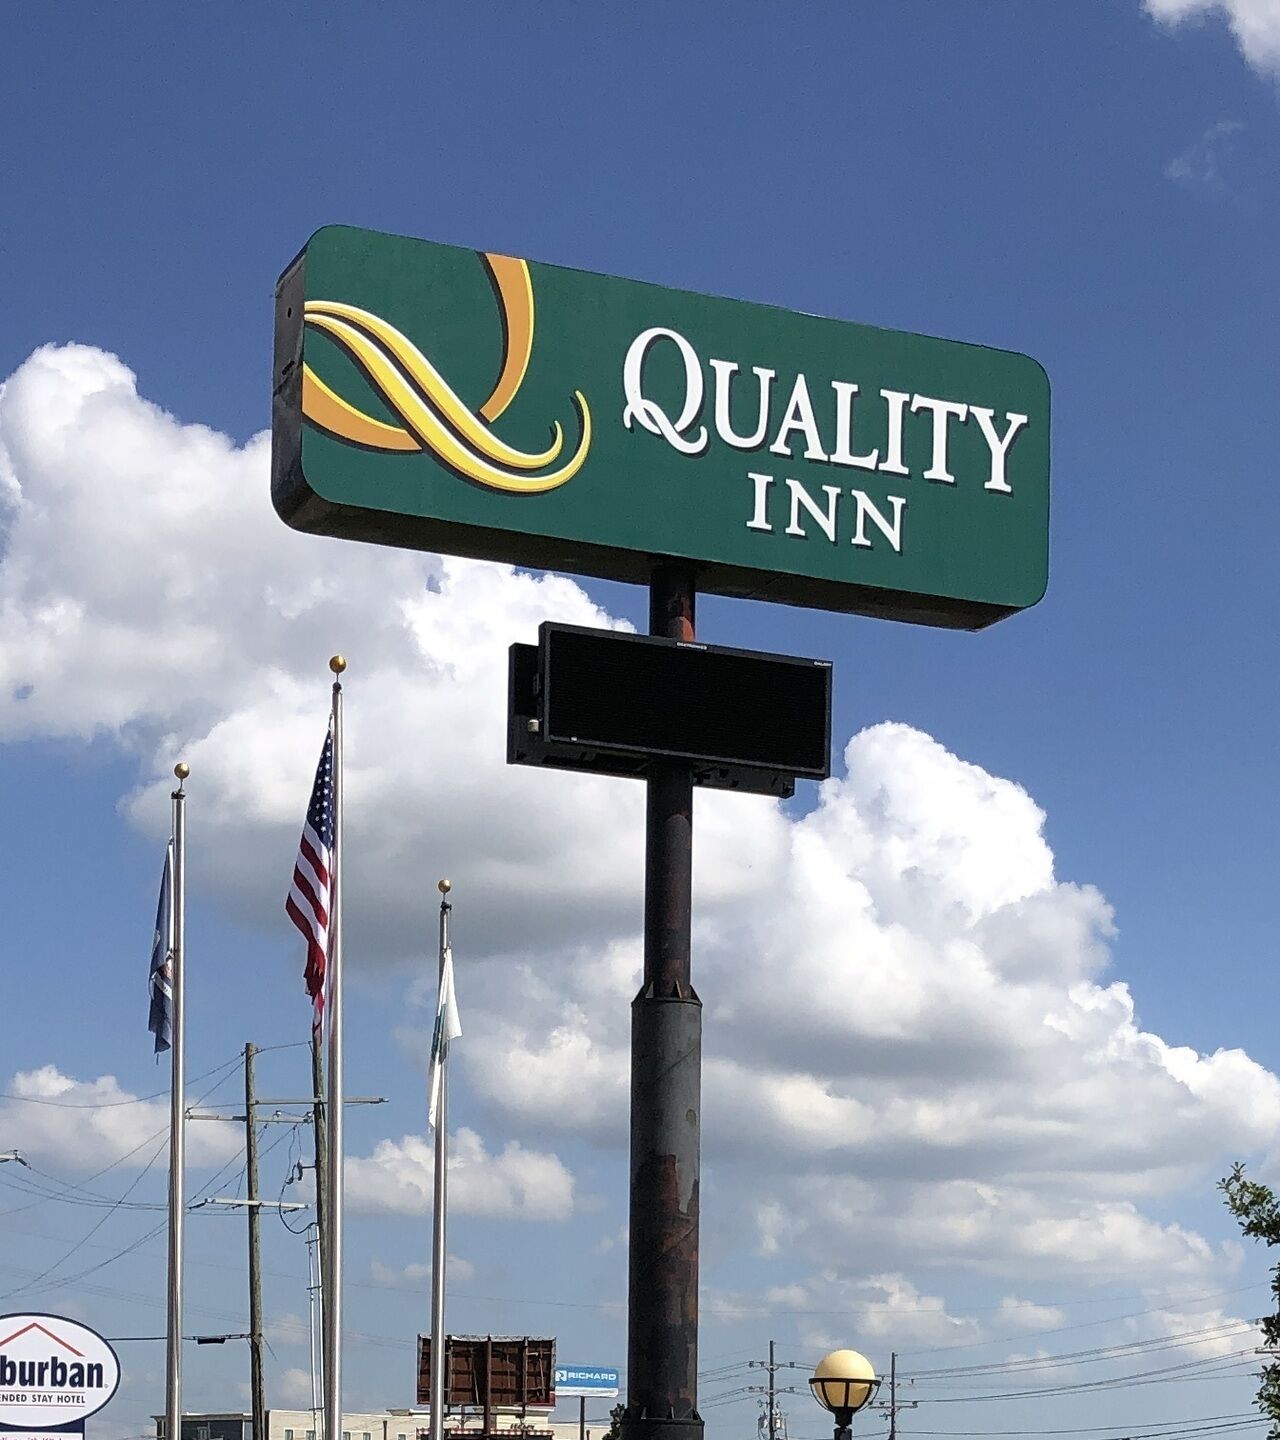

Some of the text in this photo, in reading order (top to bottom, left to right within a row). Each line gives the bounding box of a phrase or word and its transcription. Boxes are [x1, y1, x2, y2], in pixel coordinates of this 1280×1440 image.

[623, 327, 1028, 493] QUALITY
[746, 472, 906, 552] INN
[32, 1394, 53, 1403] STAY
[57, 1395, 86, 1404] HOTEL
